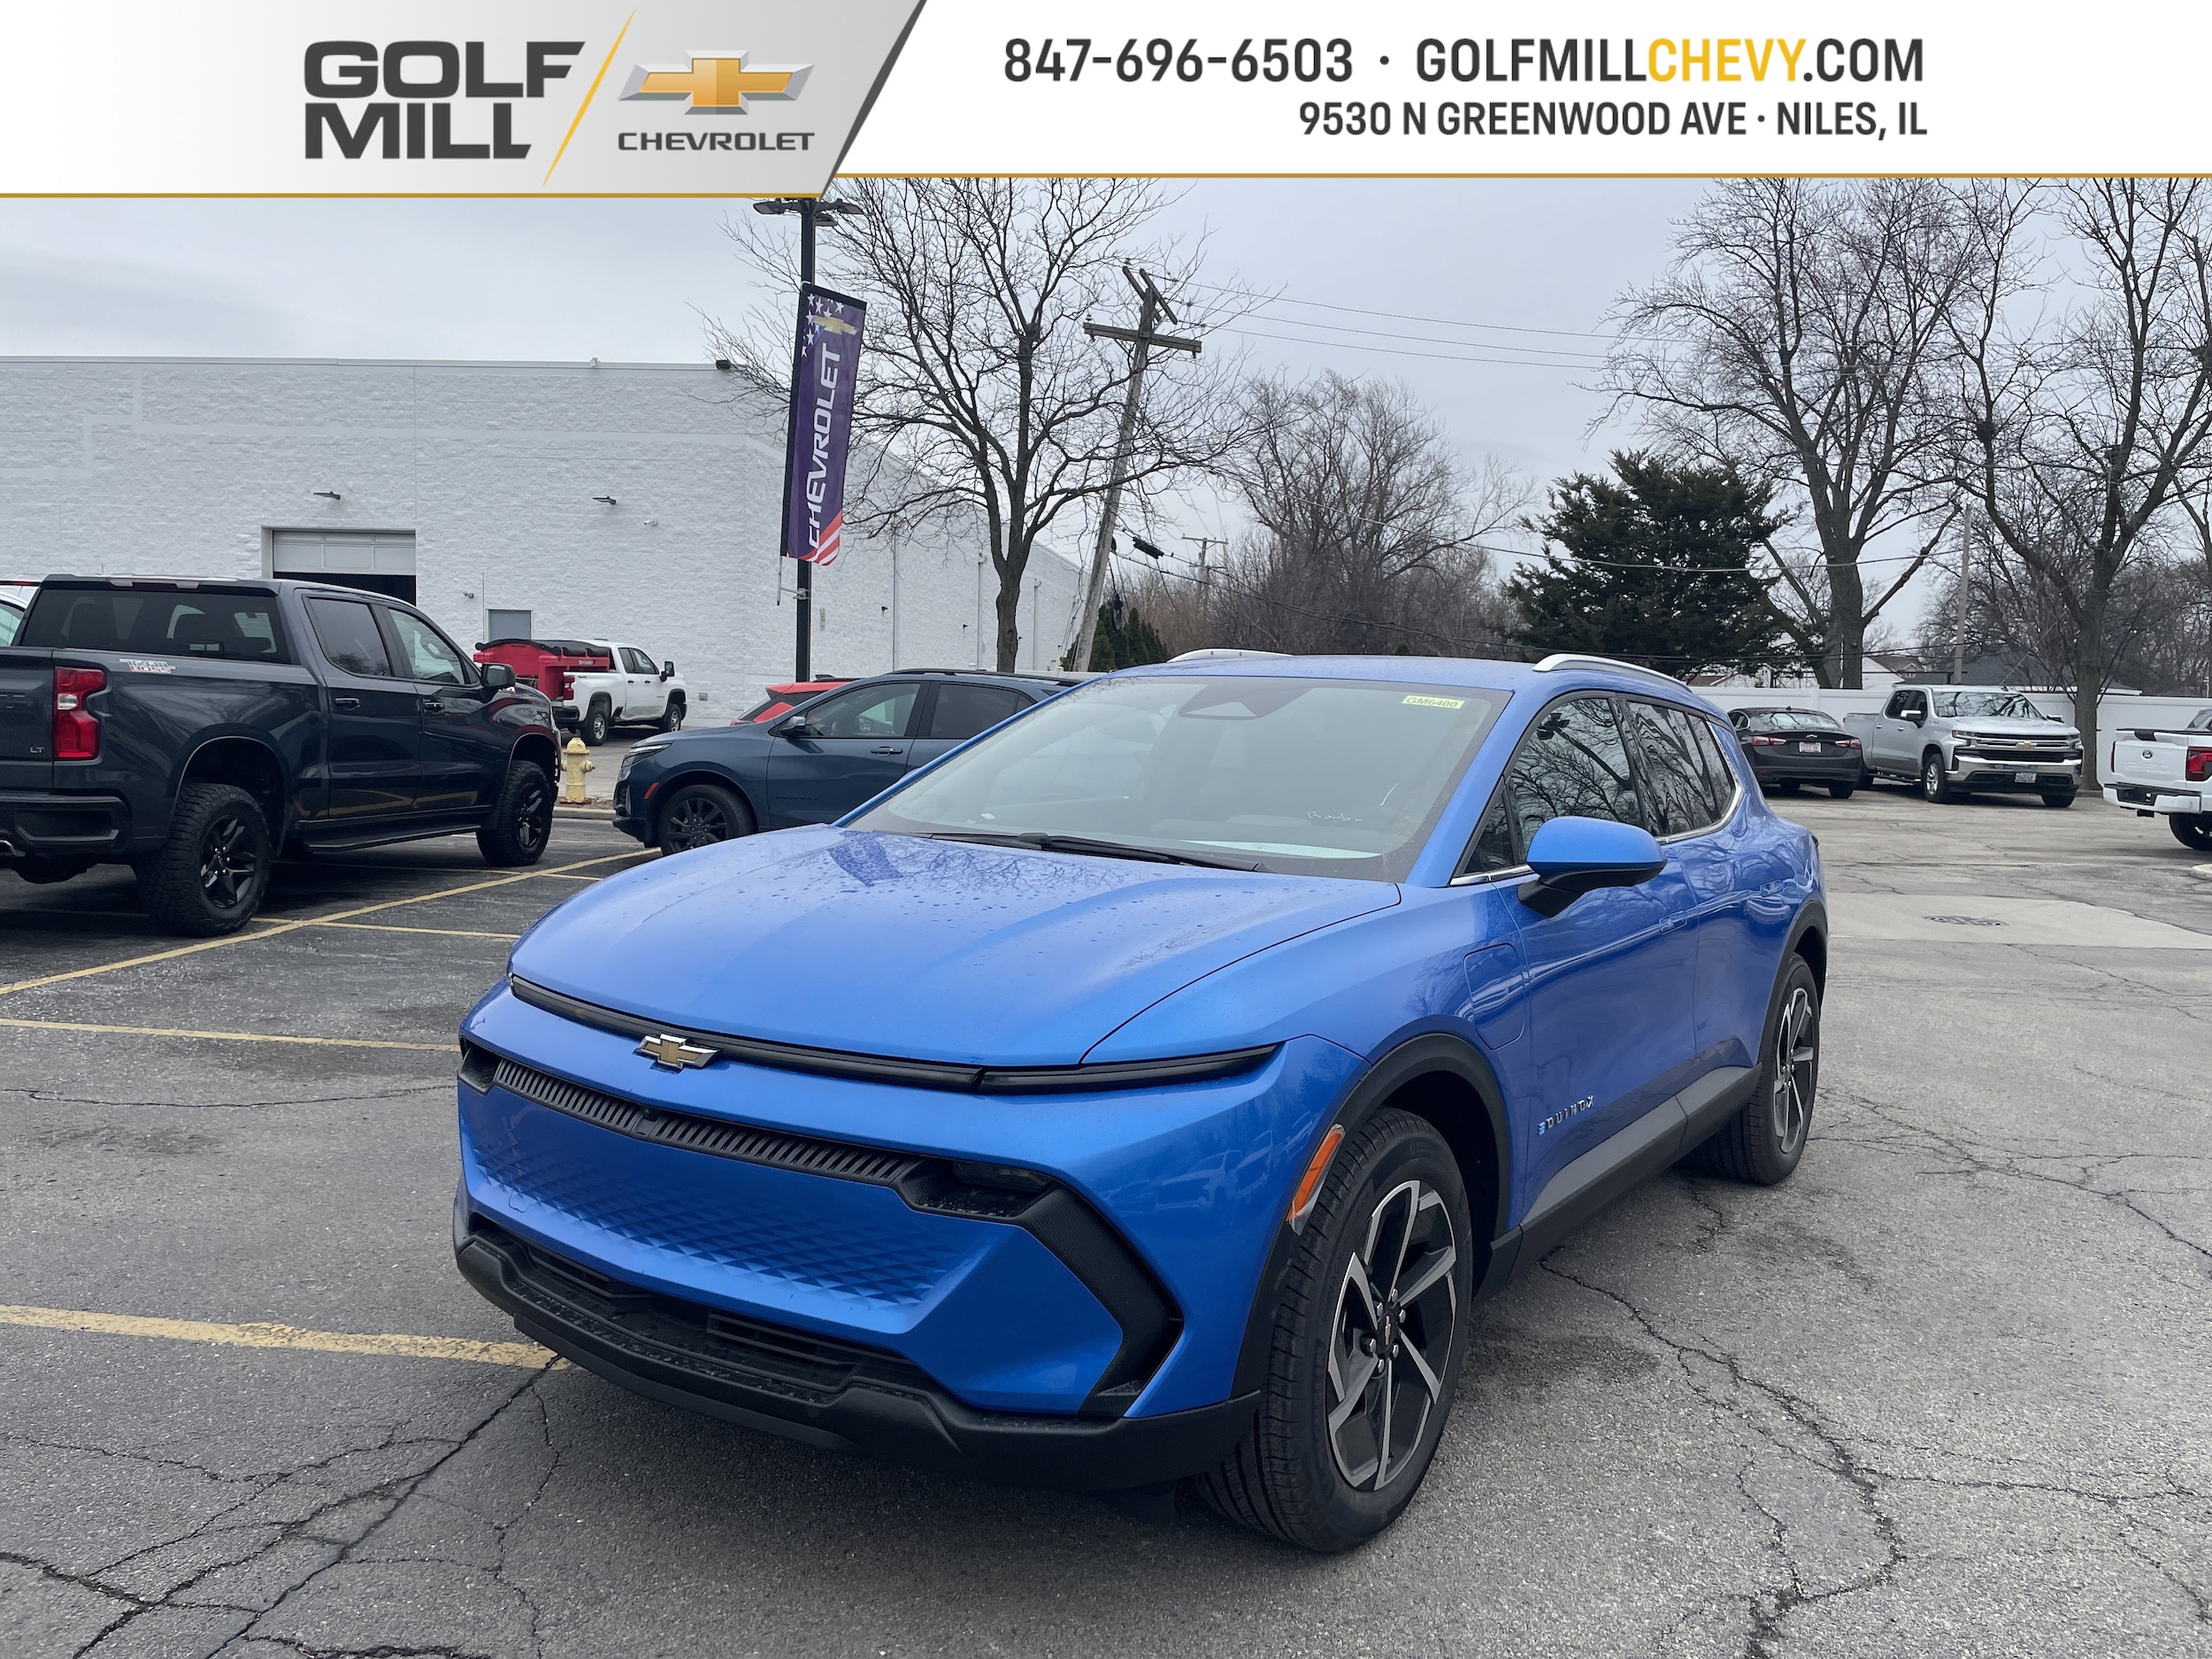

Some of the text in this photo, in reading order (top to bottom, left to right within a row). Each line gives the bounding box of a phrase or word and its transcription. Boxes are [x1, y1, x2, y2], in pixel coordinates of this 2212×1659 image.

[806, 342, 841, 549] CHEVROLET
[1406, 696, 1458, 708] GM6400
[1537, 1094, 1594, 1136] EQUINOX
